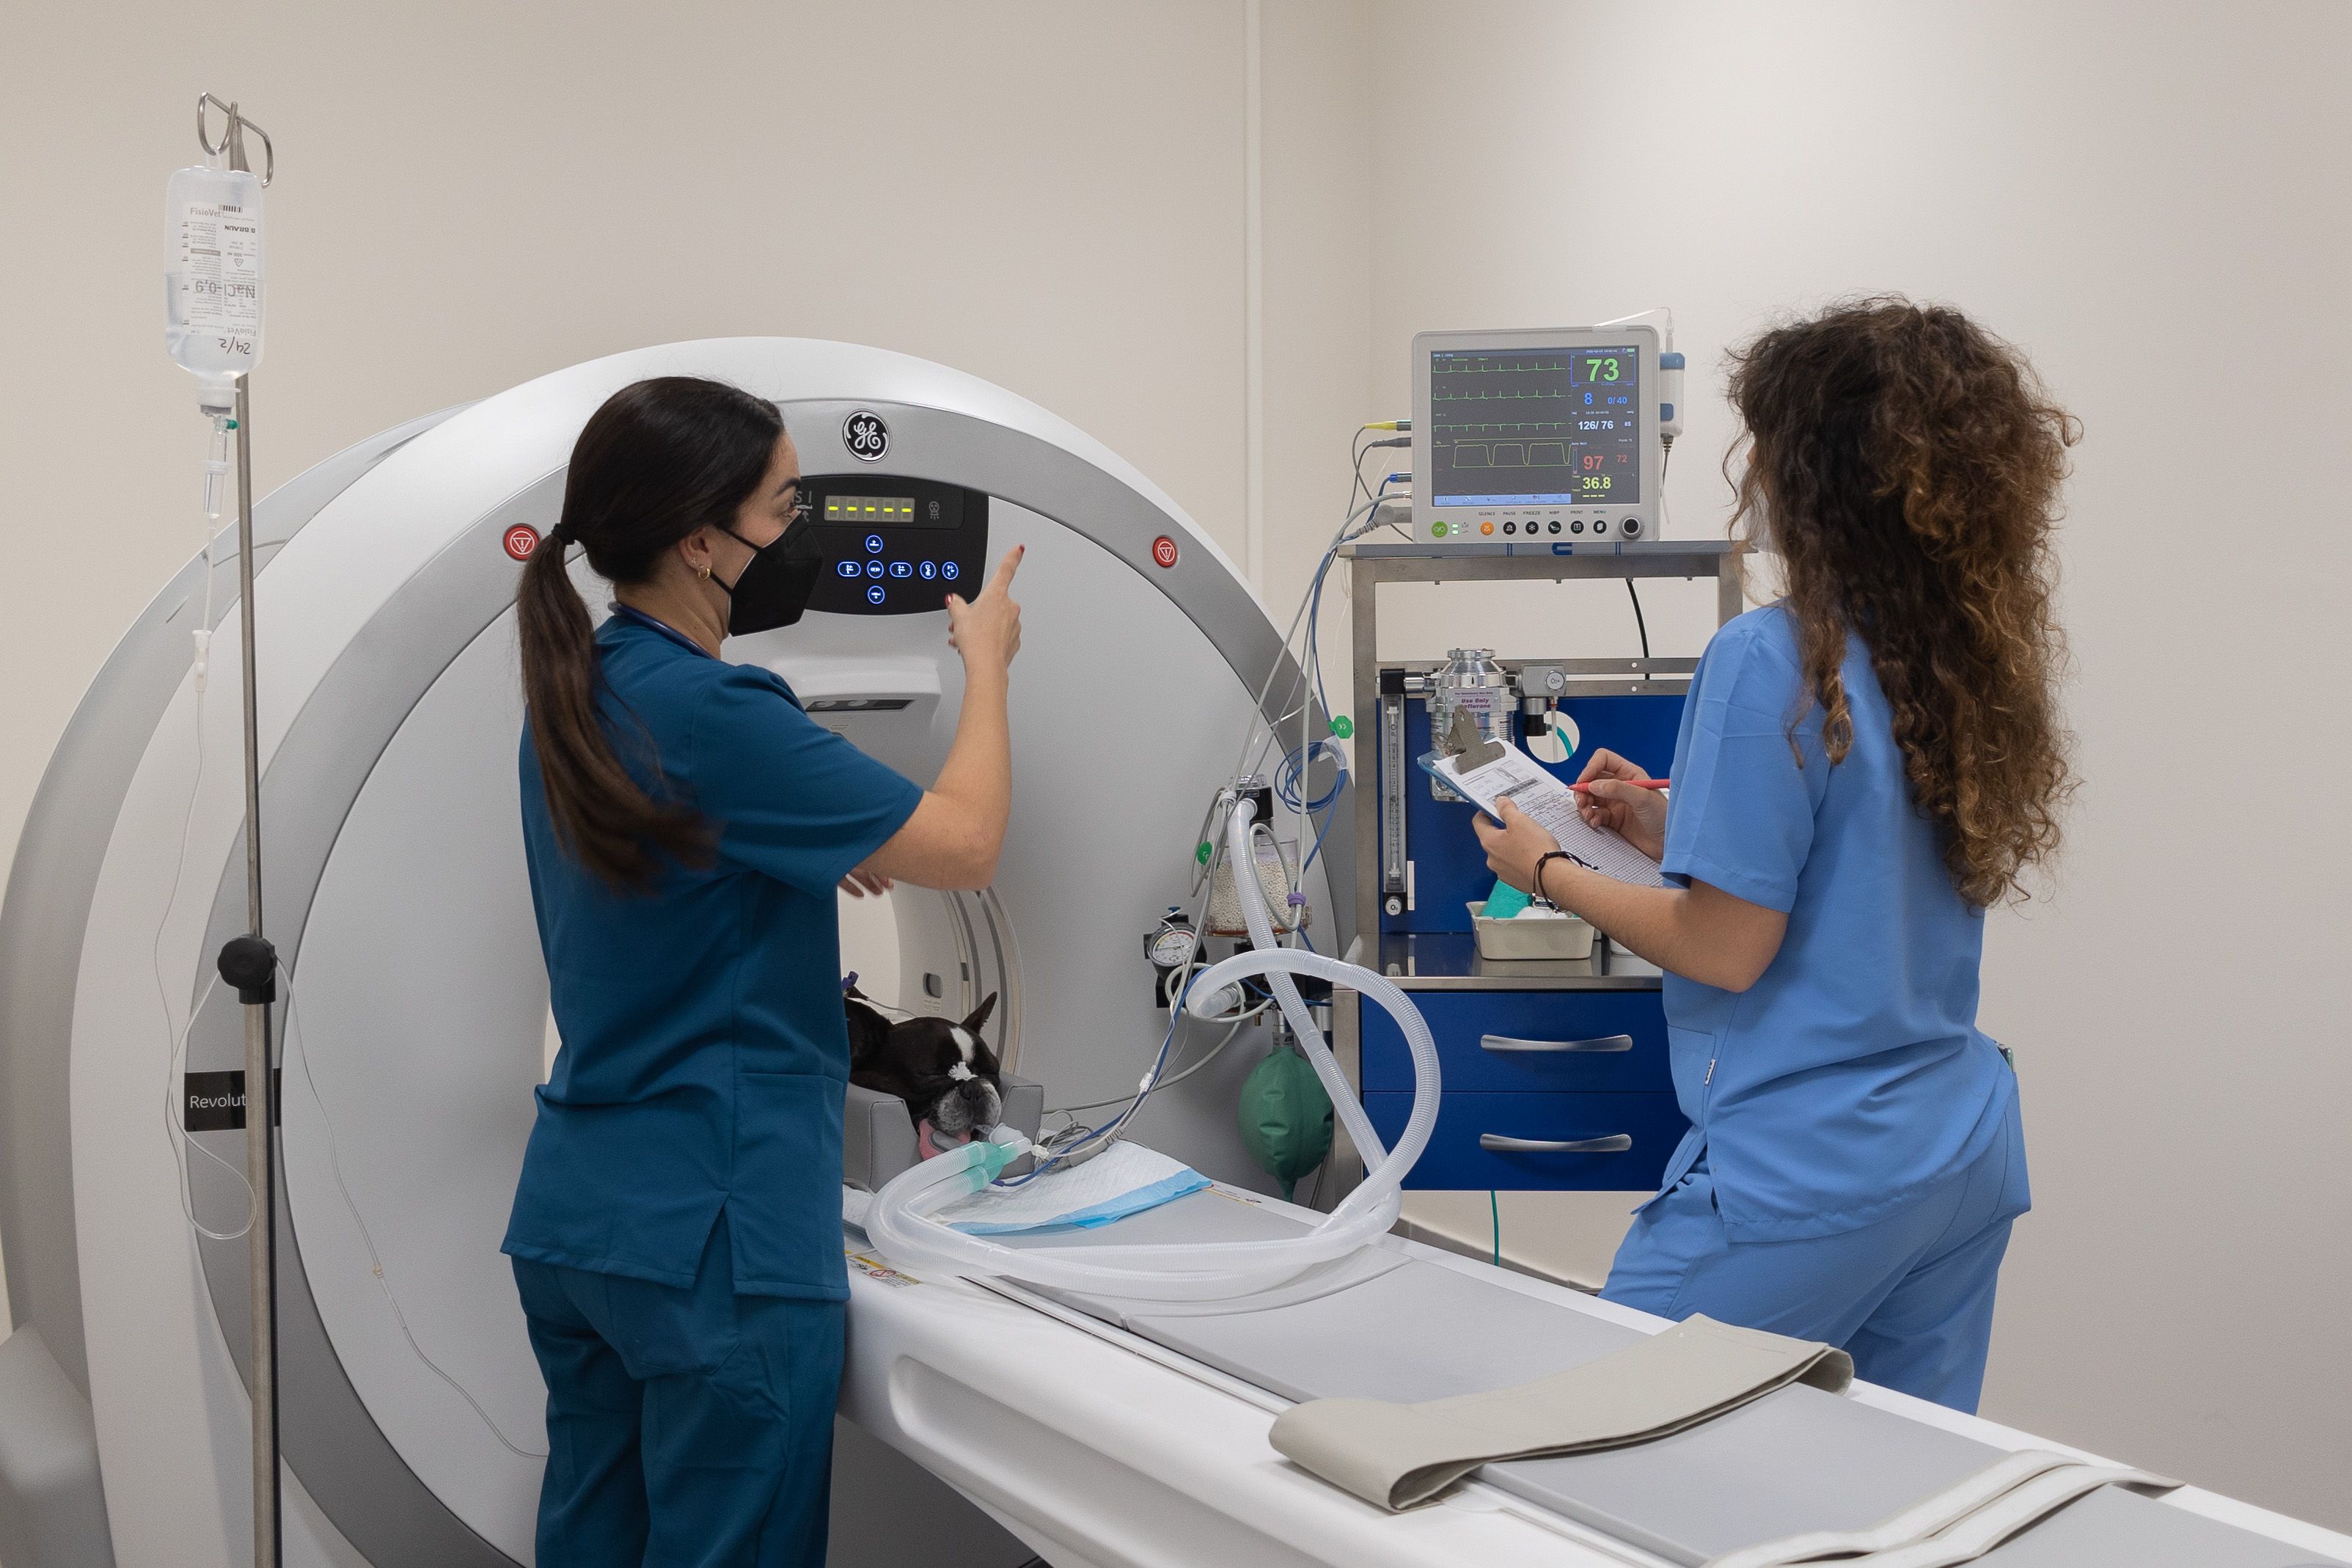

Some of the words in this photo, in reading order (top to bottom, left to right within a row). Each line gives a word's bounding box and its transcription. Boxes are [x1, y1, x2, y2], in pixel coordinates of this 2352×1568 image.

[218, 336, 251, 354] 24/2
[1586, 358, 1619, 382] 73
[1584, 392, 1593, 405] 8
[1583, 455, 1604, 470] 97
[1616, 455, 1627, 463] 72
[1583, 477, 1611, 489] 36.8
[191, 1093, 247, 1109] Revolut
